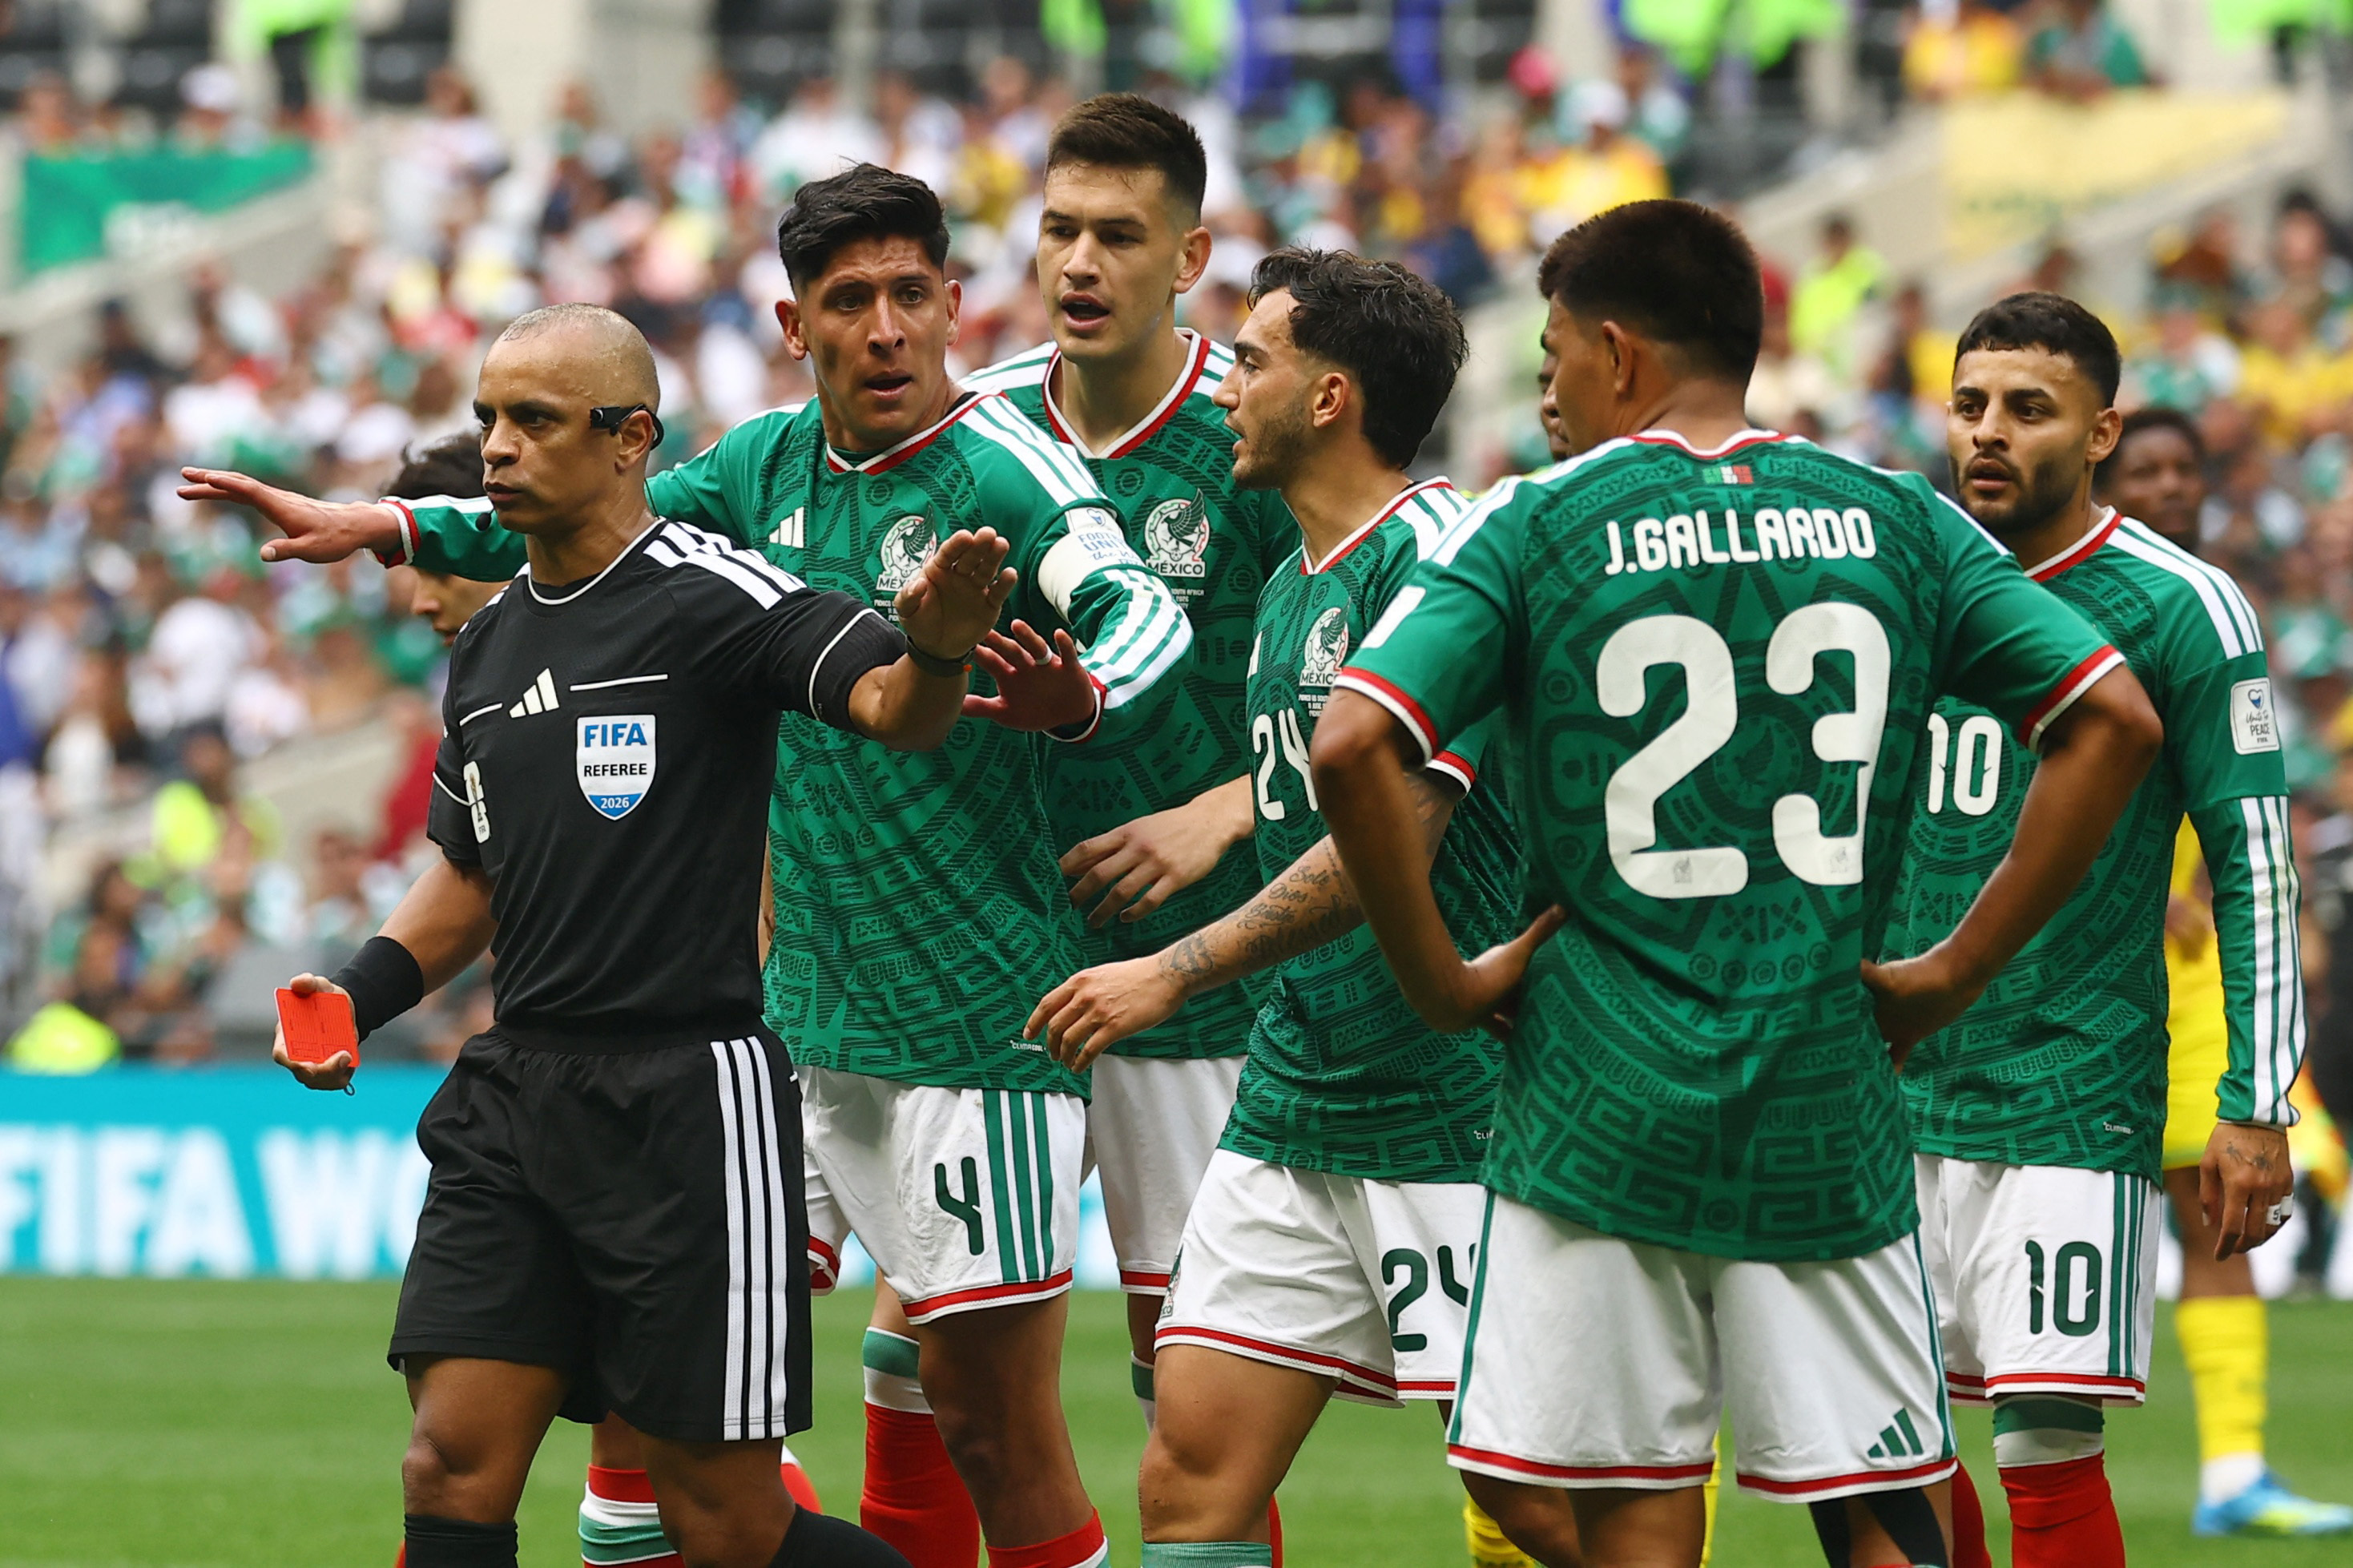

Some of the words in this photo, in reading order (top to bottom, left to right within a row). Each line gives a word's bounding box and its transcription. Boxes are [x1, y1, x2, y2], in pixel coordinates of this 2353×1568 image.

[1147, 560, 1203, 575] MÉXICO
[1605, 508, 1876, 575] J.GALLARDO
[584, 723, 647, 748] FIFA
[584, 763, 647, 777] REFEREE
[1252, 707, 1320, 821] 24
[1596, 601, 1892, 899] 23
[1927, 712, 2003, 816] 10
[600, 796, 630, 809] 2026
[0, 1123, 255, 1280] FIFA
[934, 1156, 985, 1256] 4
[2025, 1239, 2103, 1337] 10
